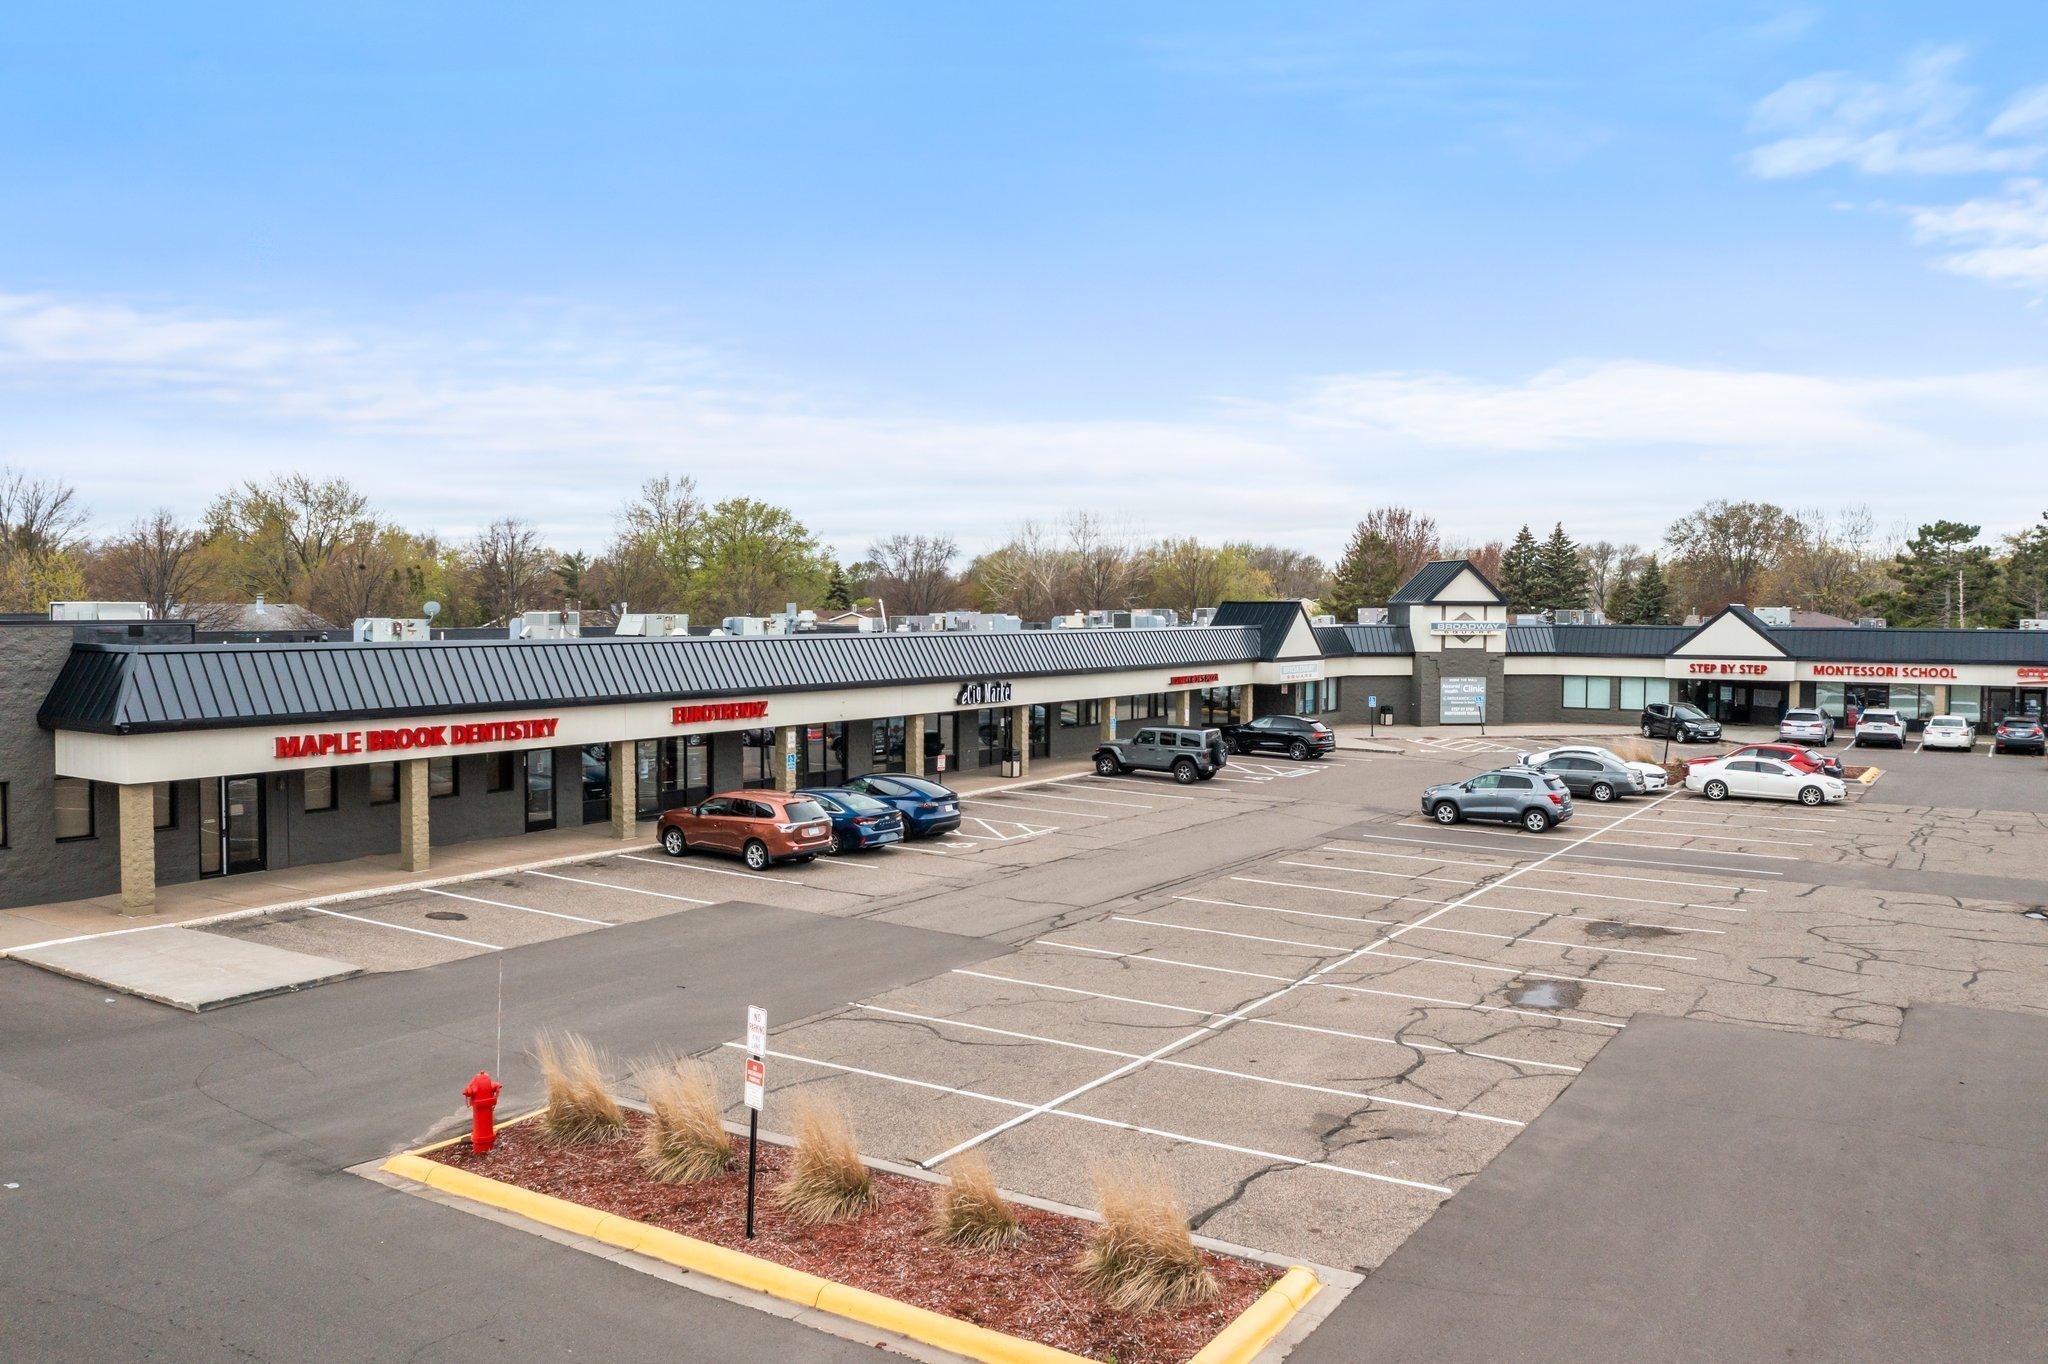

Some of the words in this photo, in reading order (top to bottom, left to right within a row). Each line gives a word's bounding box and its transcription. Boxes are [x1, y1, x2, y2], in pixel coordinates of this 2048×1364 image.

[1689, 663, 1717, 674] STEP
[1720, 664, 1736, 674] BY
[1739, 664, 1768, 675] STEP
[1813, 665, 1899, 677] MONTESSORI
[1902, 667, 1958, 678] SCHOOL
[960, 684, 982, 705] eCig
[984, 682, 1013, 704] Market
[1462, 684, 1485, 693] Clinic
[672, 701, 769, 725] EUROTRENDZ
[275, 732, 361, 759] MAPLE
[366, 726, 447, 751] BROOK
[451, 718, 559, 744] DENTISTRY
